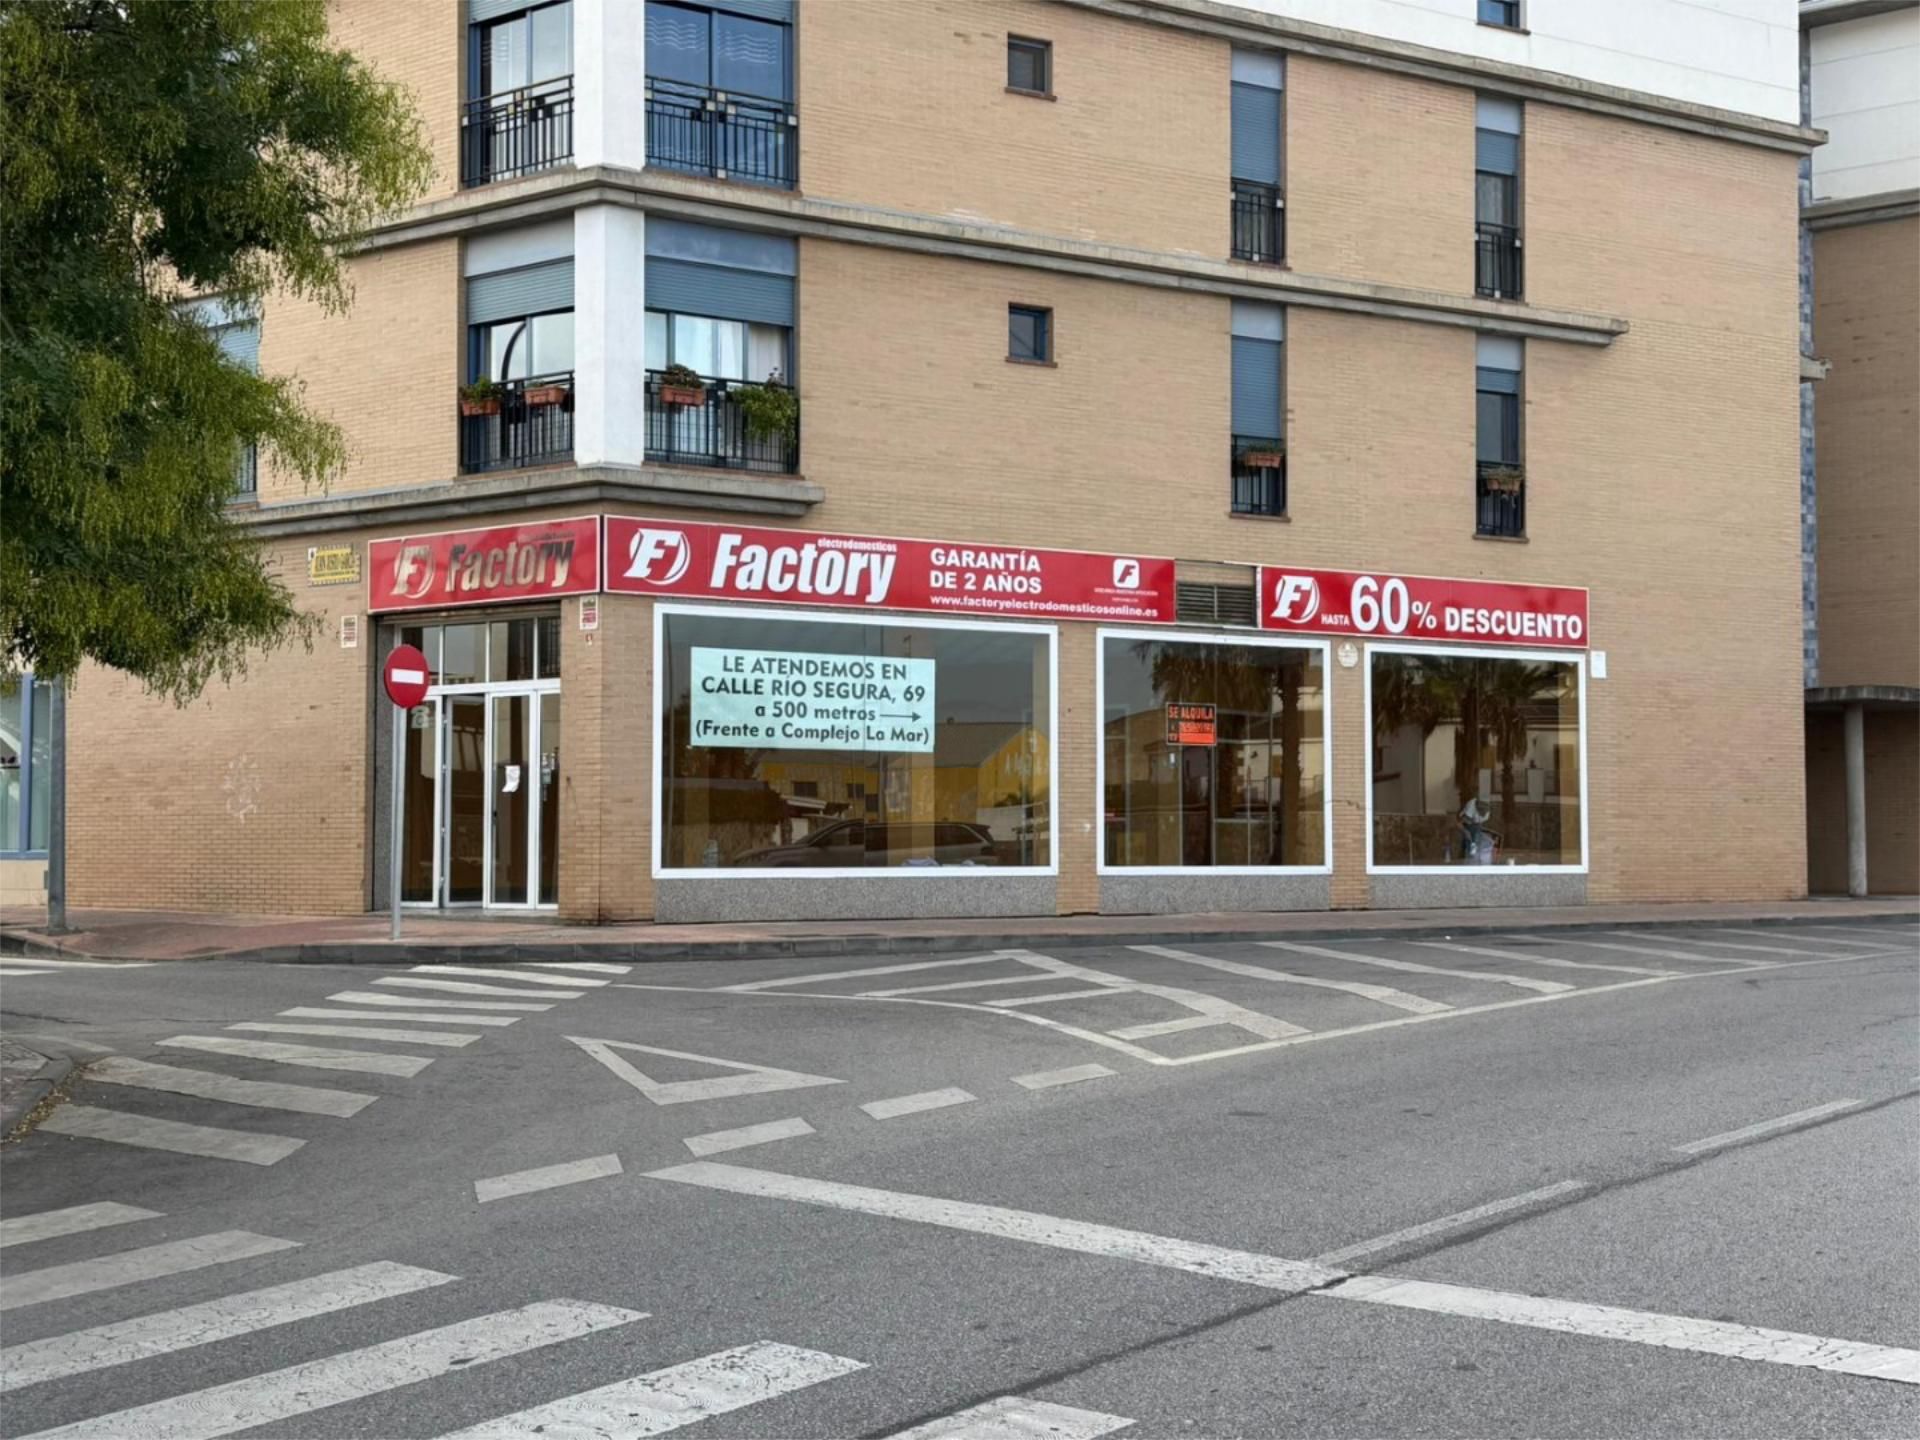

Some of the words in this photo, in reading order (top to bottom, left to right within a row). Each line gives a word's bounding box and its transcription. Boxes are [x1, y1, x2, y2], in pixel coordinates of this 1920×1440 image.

[817, 537, 897, 552] electrodomesticos
[445, 540, 575, 592] Factory
[710, 533, 897, 603] Factory
[930, 547, 1041, 572] GARANTÍA
[930, 570, 958, 589] DE
[964, 572, 976, 590] 2
[983, 572, 1042, 594] AÑOS
[930, 595, 1158, 617] www.factoryelectrodomesticosonline.es
[1321, 612, 1350, 626] HASTA
[1444, 606, 1583, 640] DESCUENTO
[723, 655, 744, 673] LE
[750, 657, 875, 680] ATENDEMOS
[882, 664, 907, 680] EN
[701, 676, 764, 695] CALLE
[771, 674, 807, 697] RÍO
[813, 681, 896, 704] SEGURA,
[903, 685, 925, 702] 69
[755, 703, 766, 717] a
[772, 701, 807, 718] 500
[814, 705, 876, 721] metros
[695, 719, 760, 738] (Frente
[765, 725, 775, 738] a
[781, 722, 860, 743] Complejo
[866, 726, 885, 741] La
[891, 727, 929, 745] Mar)
